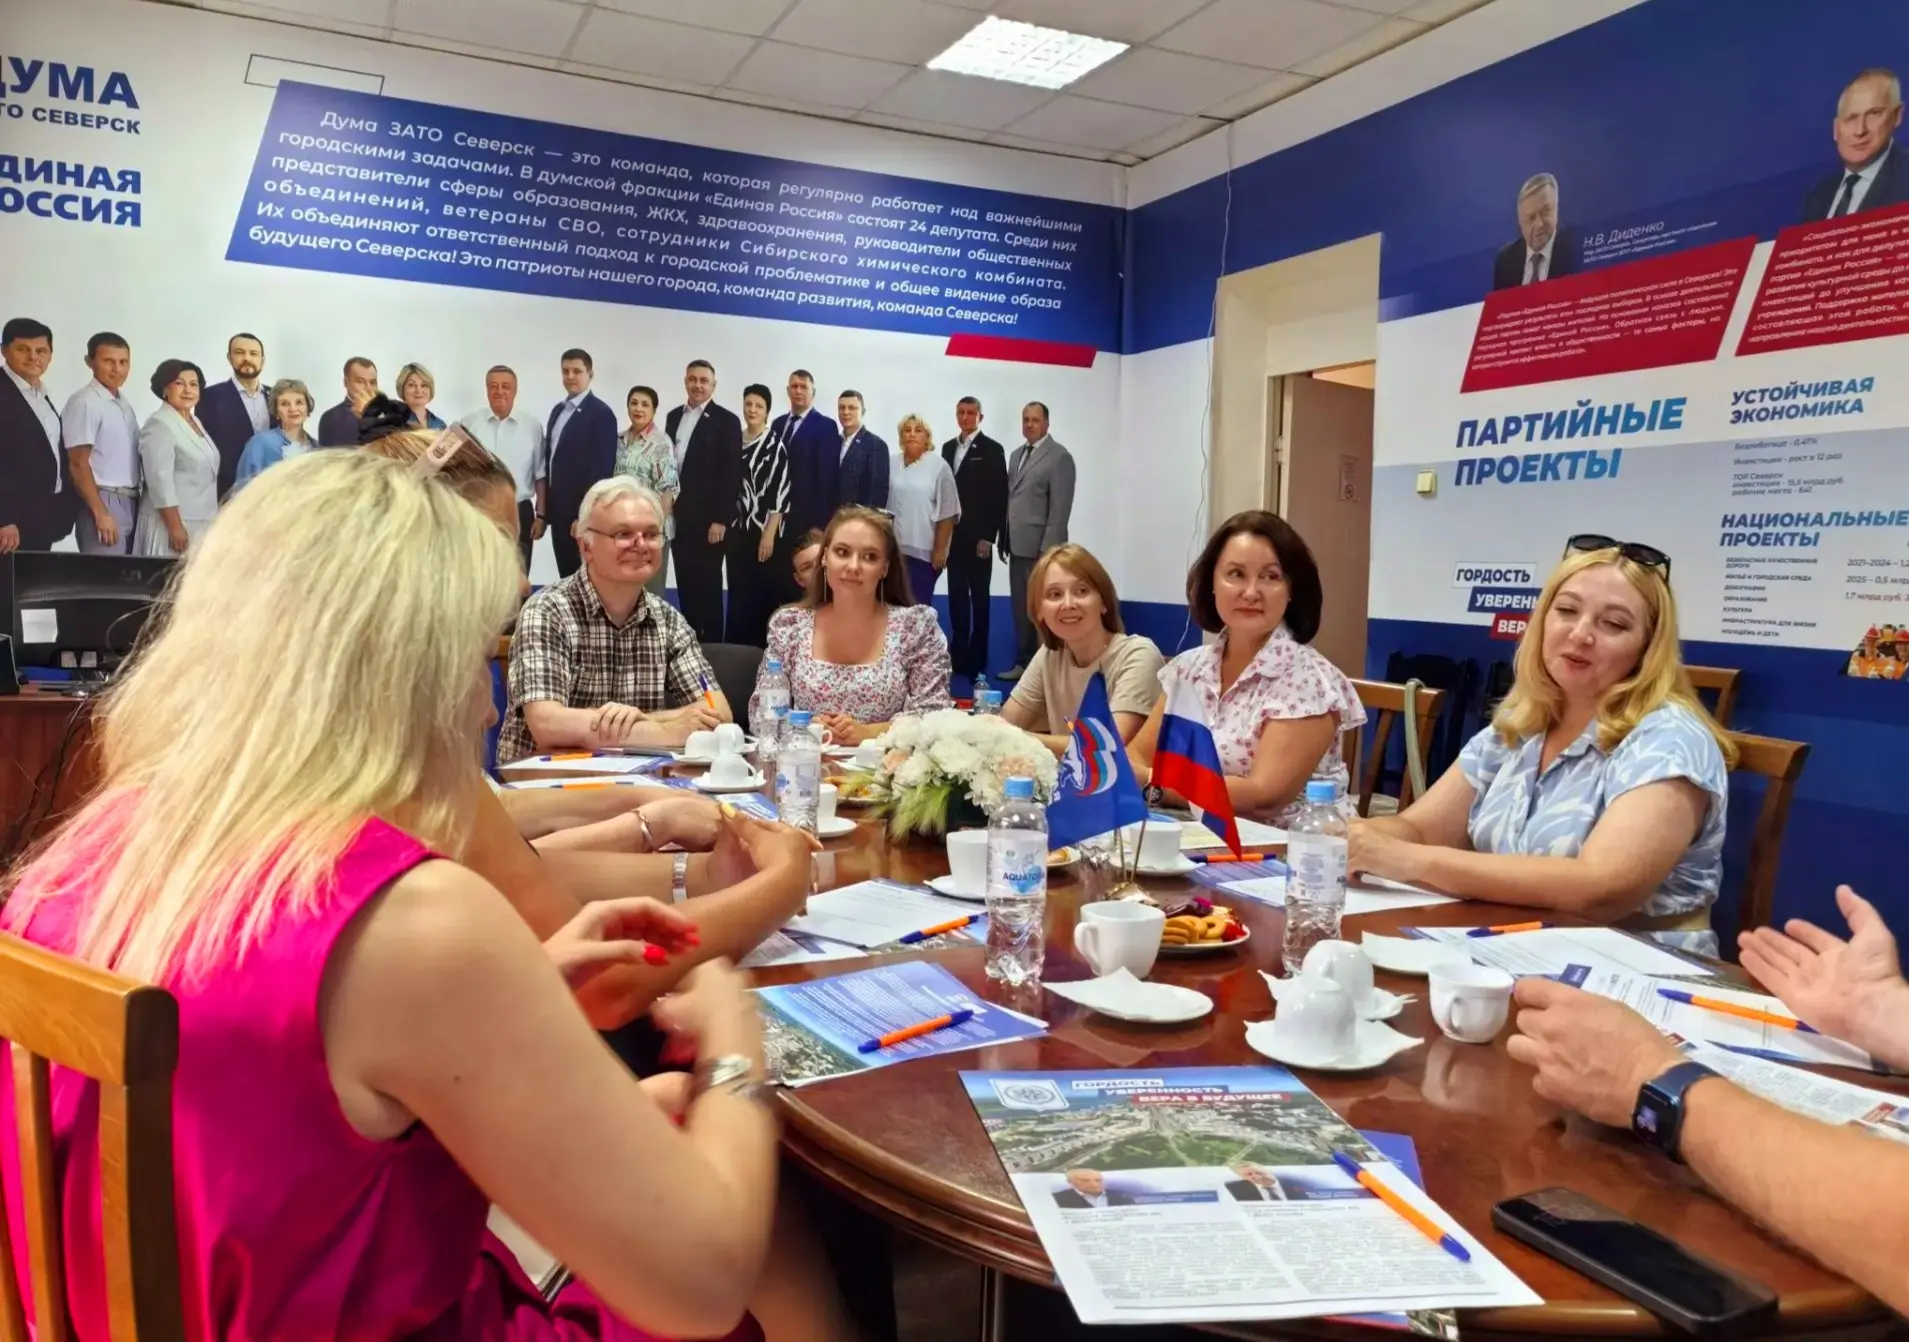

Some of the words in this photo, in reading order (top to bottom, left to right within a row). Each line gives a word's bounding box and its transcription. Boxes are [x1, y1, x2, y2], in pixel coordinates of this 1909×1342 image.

[32, 107, 141, 135] СЕВЕРСК
[320, 111, 378, 133] Дума
[388, 121, 443, 142] ЗАТО
[454, 131, 536, 156] Северск
[571, 152, 601, 166] это
[611, 157, 693, 181] команда,
[702, 171, 771, 191] которая
[779, 182, 864, 204] регулярно
[871, 196, 943, 214] работает
[950, 206, 978, 221] над
[985, 211, 1082, 233] важнейшими
[279, 132, 405, 161] городскими
[411, 151, 514, 177] задачами.
[520, 165, 533, 179] В
[536, 170, 616, 192] думской
[621, 180, 699, 203] фракции
[704, 192, 775, 213] «Единая
[779, 202, 843, 222] Россия»
[847, 213, 906, 231] состоят
[908, 219, 927, 233] 24
[930, 223, 1000, 243] депутата.
[1004, 231, 1048, 249] Среди
[1052, 239, 1078, 252] них
[272, 156, 430, 188] представители
[440, 179, 503, 199] сферы
[513, 189, 638, 218] образования,
[646, 205, 689, 225] ЖКХ,
[697, 214, 847, 245] здравоохранения,
[855, 234, 961, 258] руководители
[967, 248, 1072, 271] общественных
[264, 179, 430, 215] объединений,
[443, 204, 547, 228] ветераны
[558, 216, 605, 237] СВО,
[616, 226, 730, 250] сотрудники
[740, 239, 848, 265] Сибирского
[856, 256, 967, 279] химического
[975, 270, 1067, 291] комбината.
[1607, 221, 1665, 245] Диденко
[257, 201, 284, 218] Их
[291, 207, 420, 235] объединяют
[426, 225, 569, 254] ответственный
[575, 244, 639, 263] подход
[644, 253, 655, 264] к
[661, 254, 749, 275] городской
[754, 264, 870, 289] проблематике
[875, 280, 885, 290] и
[890, 280, 939, 296] общее
[944, 287, 1006, 304] видение
[1010, 293, 1062, 309] образа
[249, 225, 352, 252] будущего
[355, 238, 457, 264] Северска!
[459, 251, 492, 267] Это
[495, 257, 585, 279] патриоты
[588, 268, 655, 286] нашего
[657, 276, 720, 296] города,
[723, 283, 795, 301] команда
[797, 292, 875, 312] развития,
[876, 301, 944, 317] команда
[946, 306, 1018, 325] Северска!
[1731, 376, 1875, 406] УСТОЙЧИВАЯ
[1456, 397, 1688, 448] ПАРТИЙНЫЕ
[1730, 398, 1864, 424] ЭКОНОМИКА
[1454, 448, 1622, 486] ПРОЕКТЫ
[1720, 509, 1909, 530] НАЦИОНАЛЬНЫЕ
[1720, 531, 1820, 547] ПРОЕКТЫ
[1456, 569, 1531, 584] ГОРДОСТЬ
